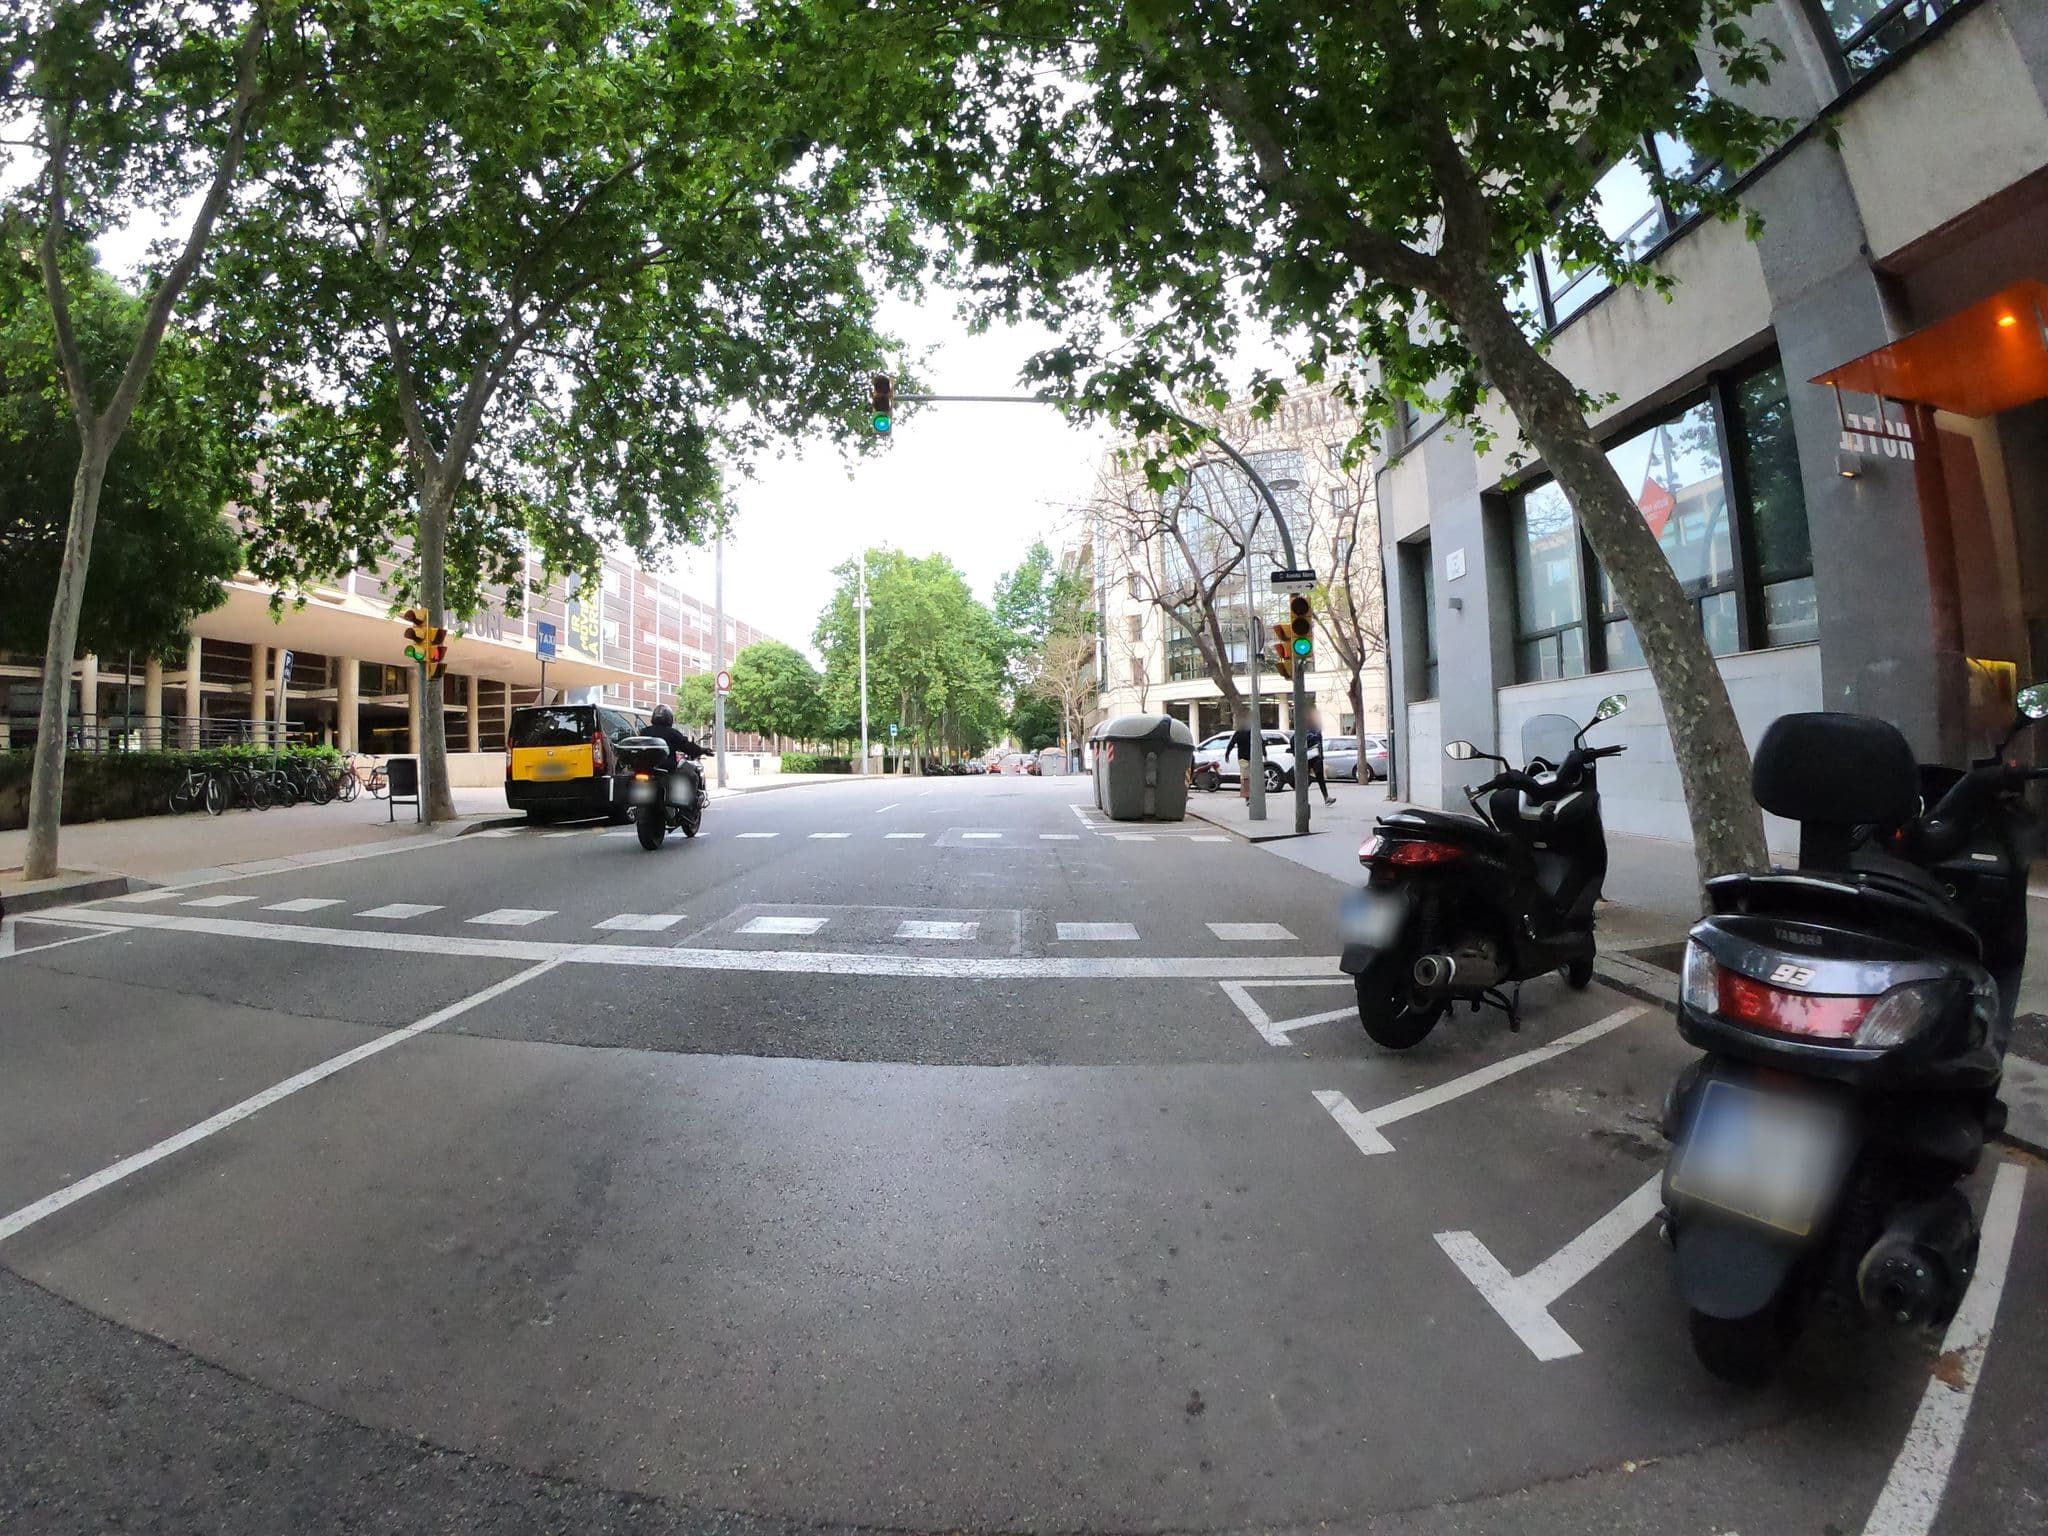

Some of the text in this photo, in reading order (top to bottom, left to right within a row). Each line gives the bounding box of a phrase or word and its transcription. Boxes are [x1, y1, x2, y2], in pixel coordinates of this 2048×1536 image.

[538, 632, 555, 644] TAXI
[1774, 928, 1823, 945] YAMAHA
[1770, 963, 1816, 986] 93
